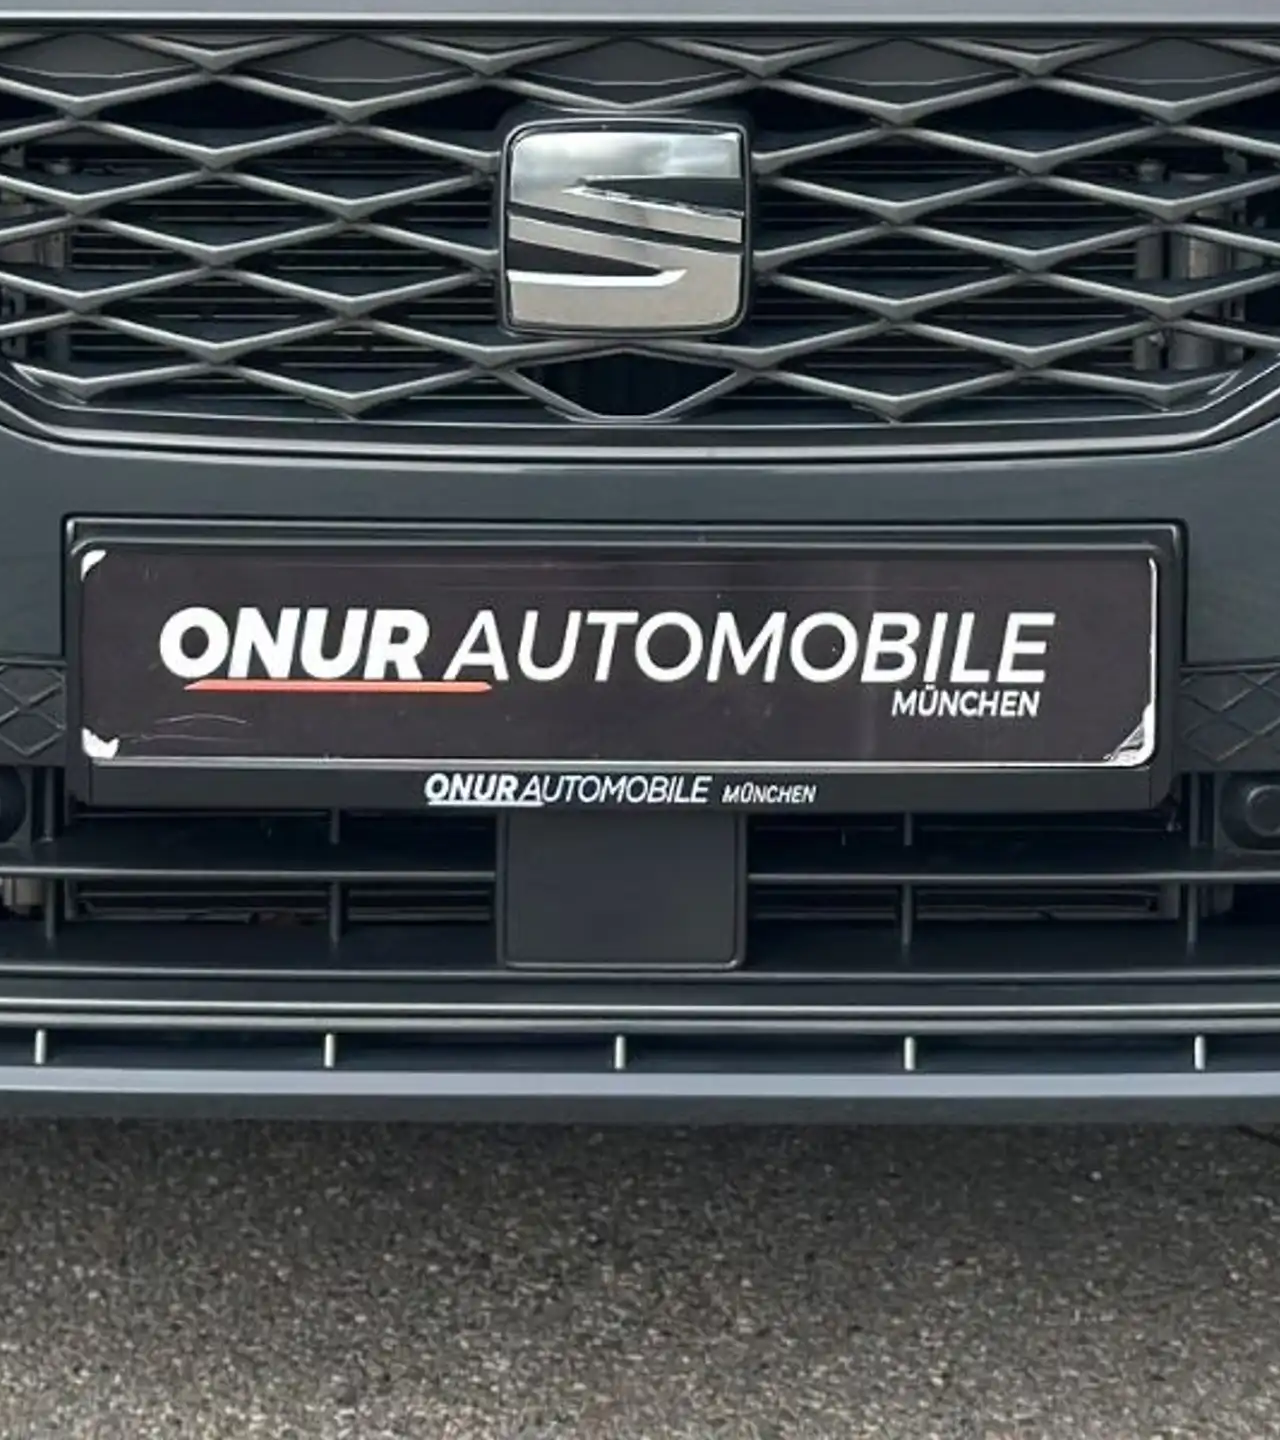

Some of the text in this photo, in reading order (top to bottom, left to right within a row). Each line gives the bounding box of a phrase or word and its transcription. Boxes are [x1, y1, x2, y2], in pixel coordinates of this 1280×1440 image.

[158, 606, 1057, 684] ONUR AUTOMOBILE
[891, 683, 1041, 718] MÜNCHEN
[721, 782, 818, 804] MÜNCHEN
